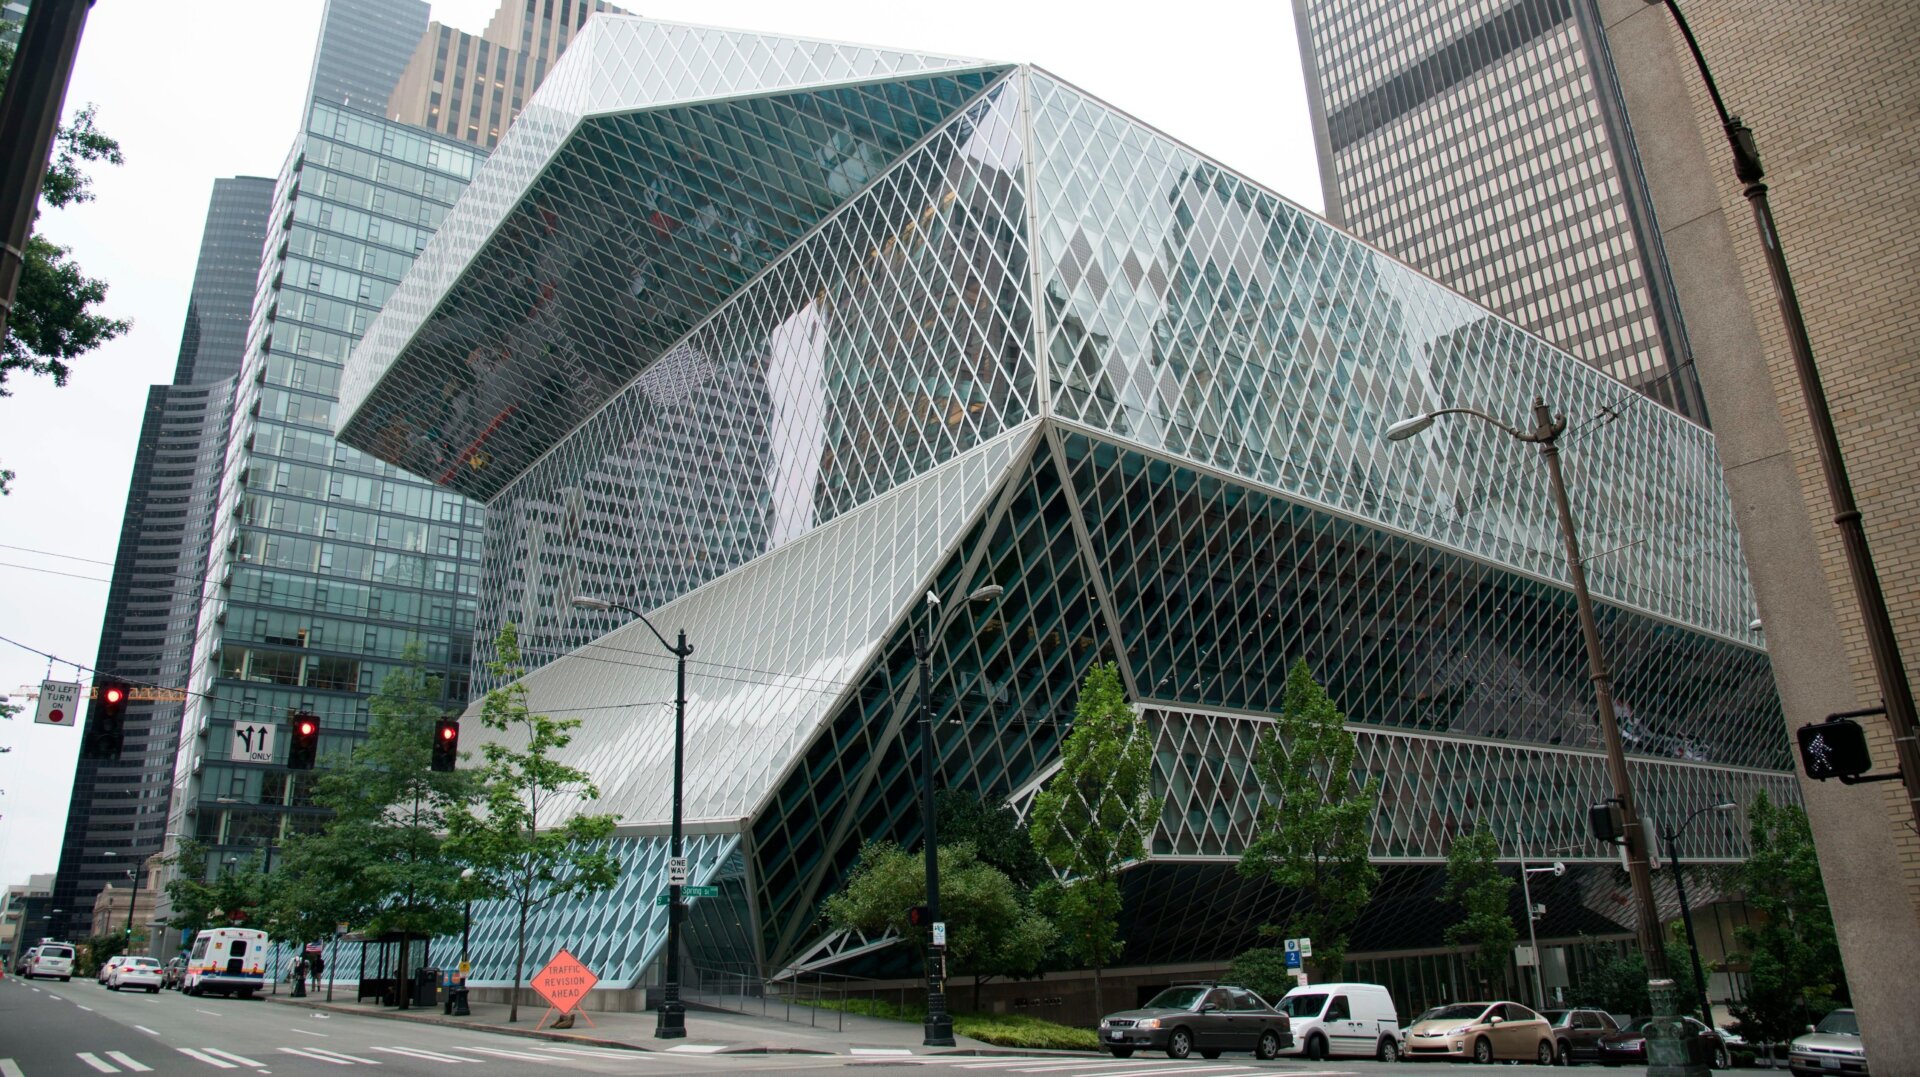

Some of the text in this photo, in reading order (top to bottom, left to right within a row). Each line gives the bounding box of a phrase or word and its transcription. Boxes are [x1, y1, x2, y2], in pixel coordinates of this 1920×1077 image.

[44, 684, 78, 694] NO LEFT
[47, 692, 72, 702] TURN
[251, 752, 272, 760] ONLY
[682, 886, 702, 896] Spring
[1290, 952, 1296, 961] 2
[548, 965, 581, 975] TRAFFIC
[544, 976, 585, 987] REVISION
[551, 988, 580, 999] AHEAD
